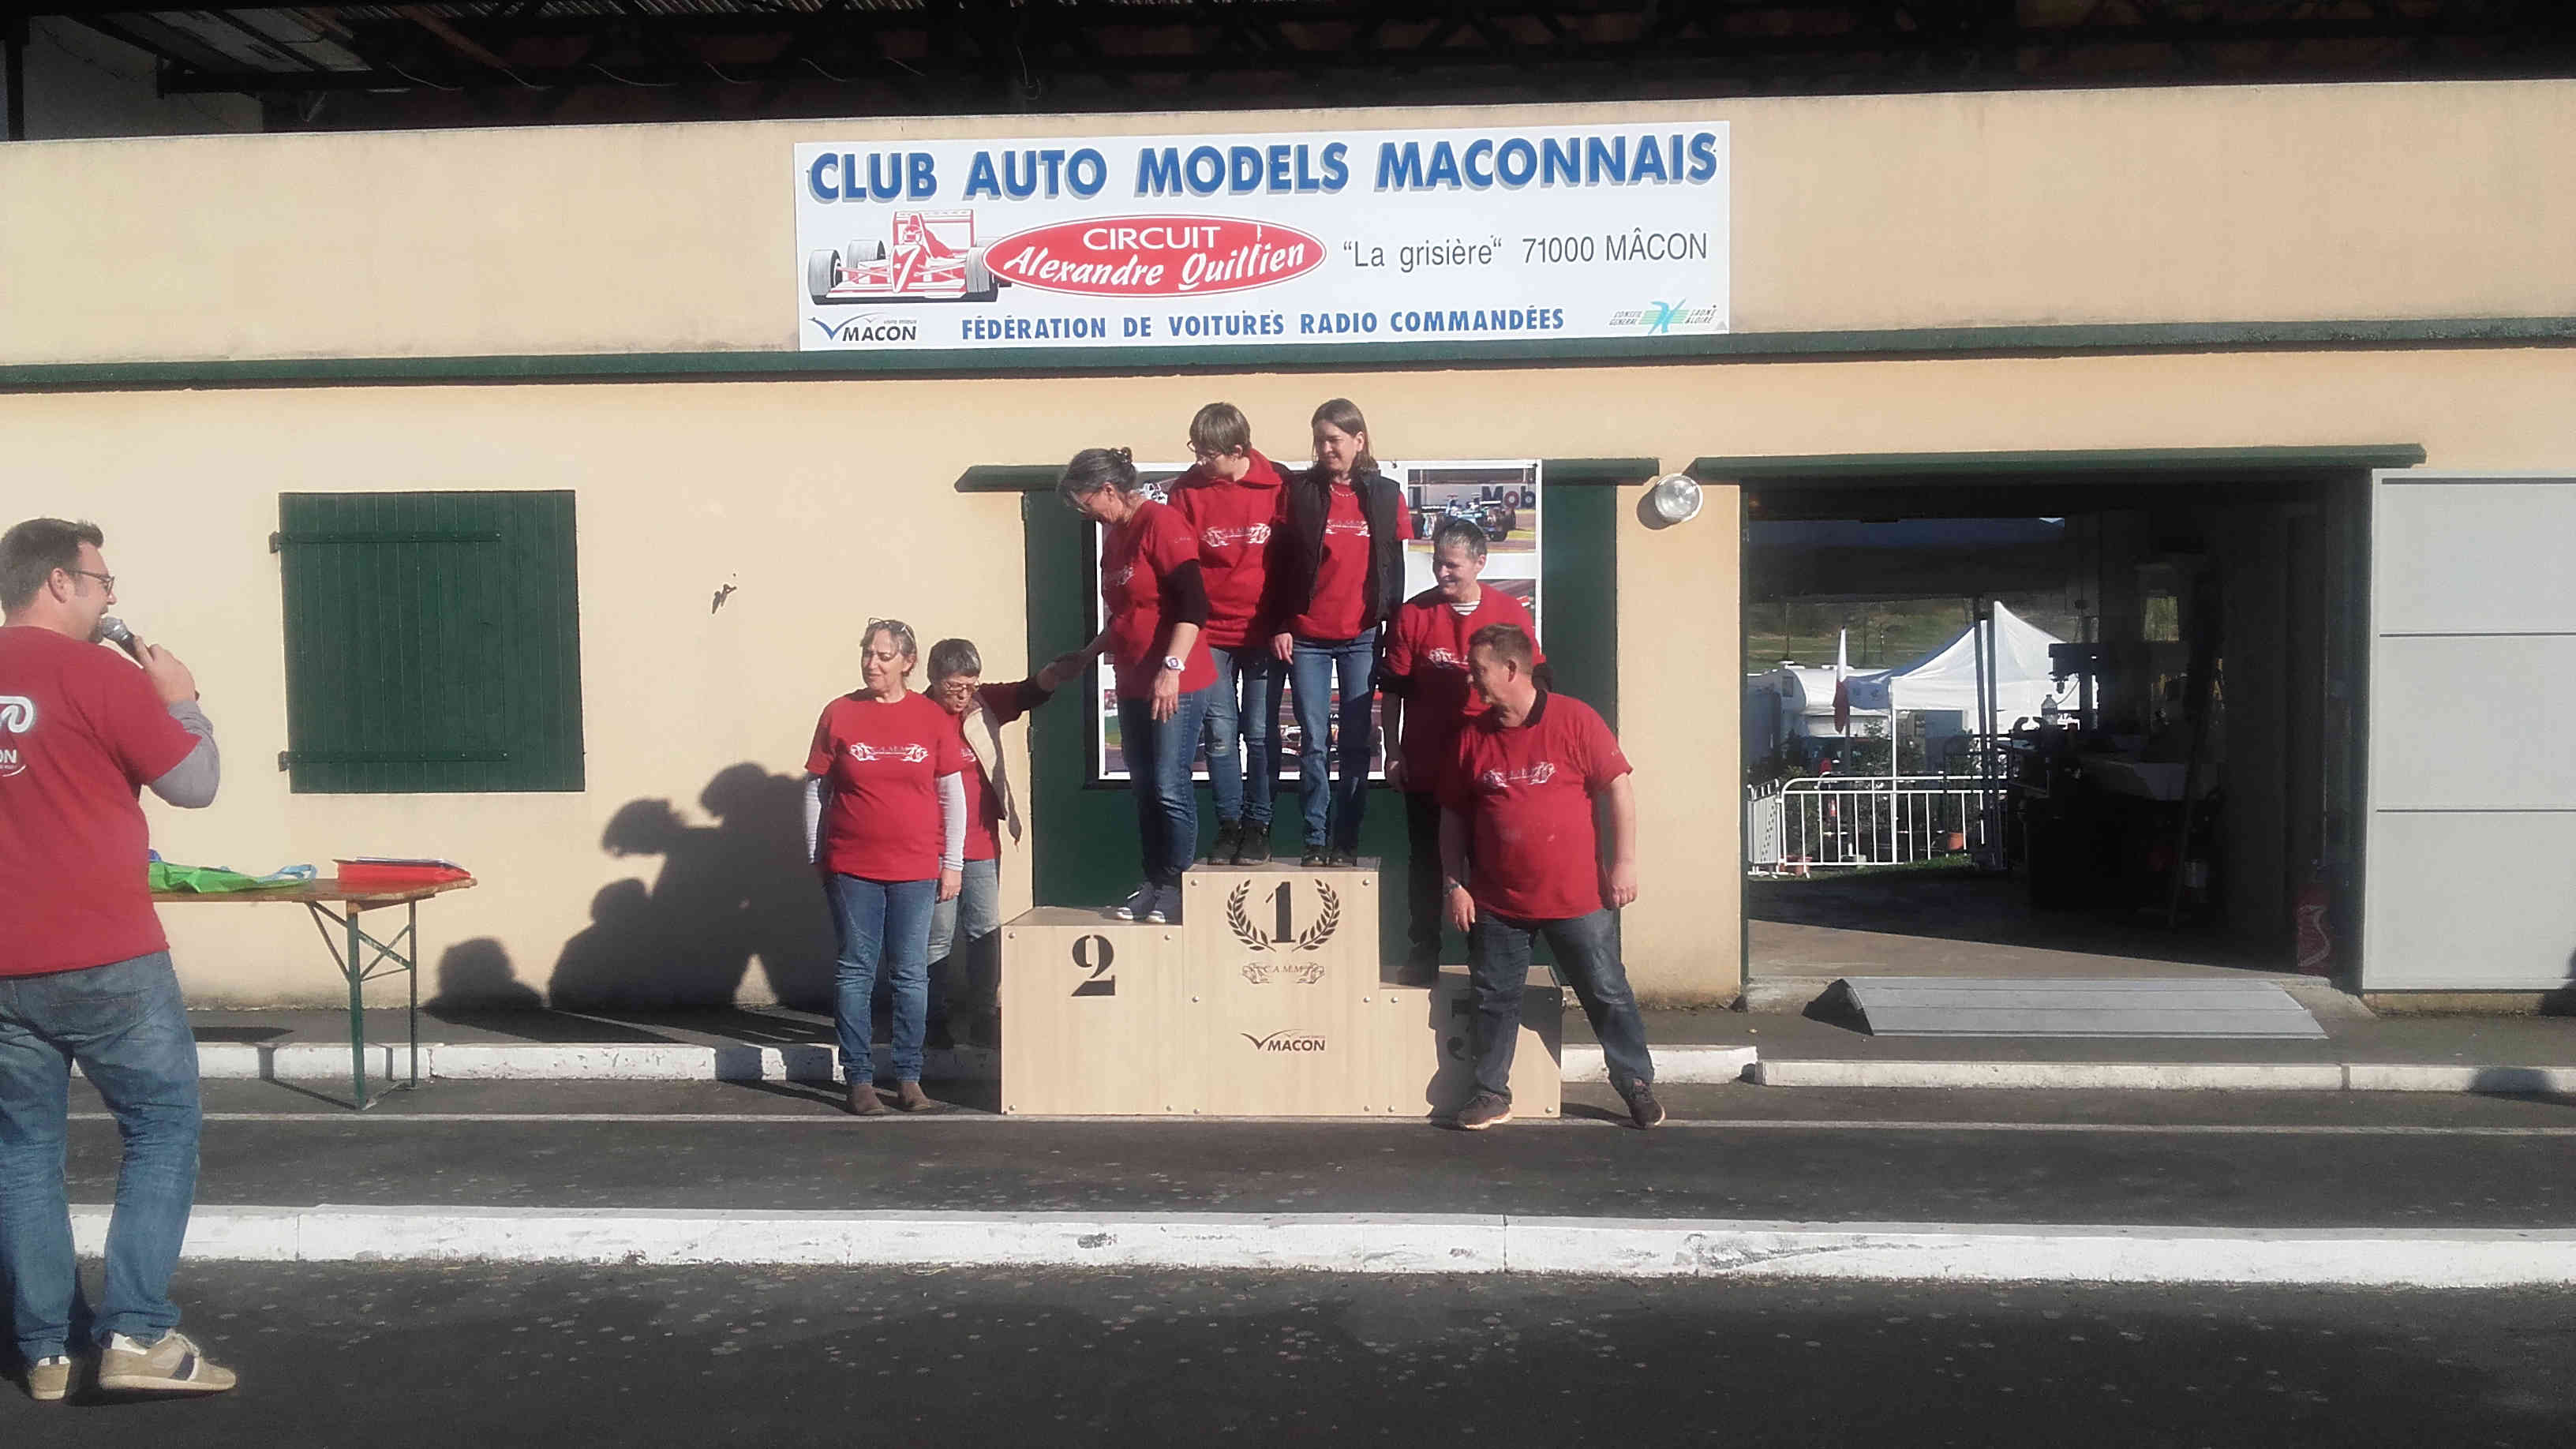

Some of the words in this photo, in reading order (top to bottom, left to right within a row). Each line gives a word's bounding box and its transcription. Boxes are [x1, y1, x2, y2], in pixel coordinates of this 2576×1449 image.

[808, 152, 938, 203] CLUB
[962, 148, 1107, 201] AUTO
[1134, 142, 1349, 199] MODELS
[1374, 132, 1718, 193] MACONNAIS
[1003, 245, 1164, 286] Alexandre
[1178, 238, 1305, 290] Quillien
[1083, 227, 1221, 250] CIRCUIT
[1522, 237, 1594, 264] 71000
[1605, 227, 1708, 262] MÂCON
[962, 315, 1106, 340] FÉDÉRATION
[1123, 317, 1152, 338] DE
[1170, 313, 1284, 338] VOITURES
[1300, 312, 1379, 335] RADIO
[1391, 306, 1565, 333] COMMANDÉES
[1265, 881, 1297, 944] 1
[1071, 934, 1117, 998] 2
